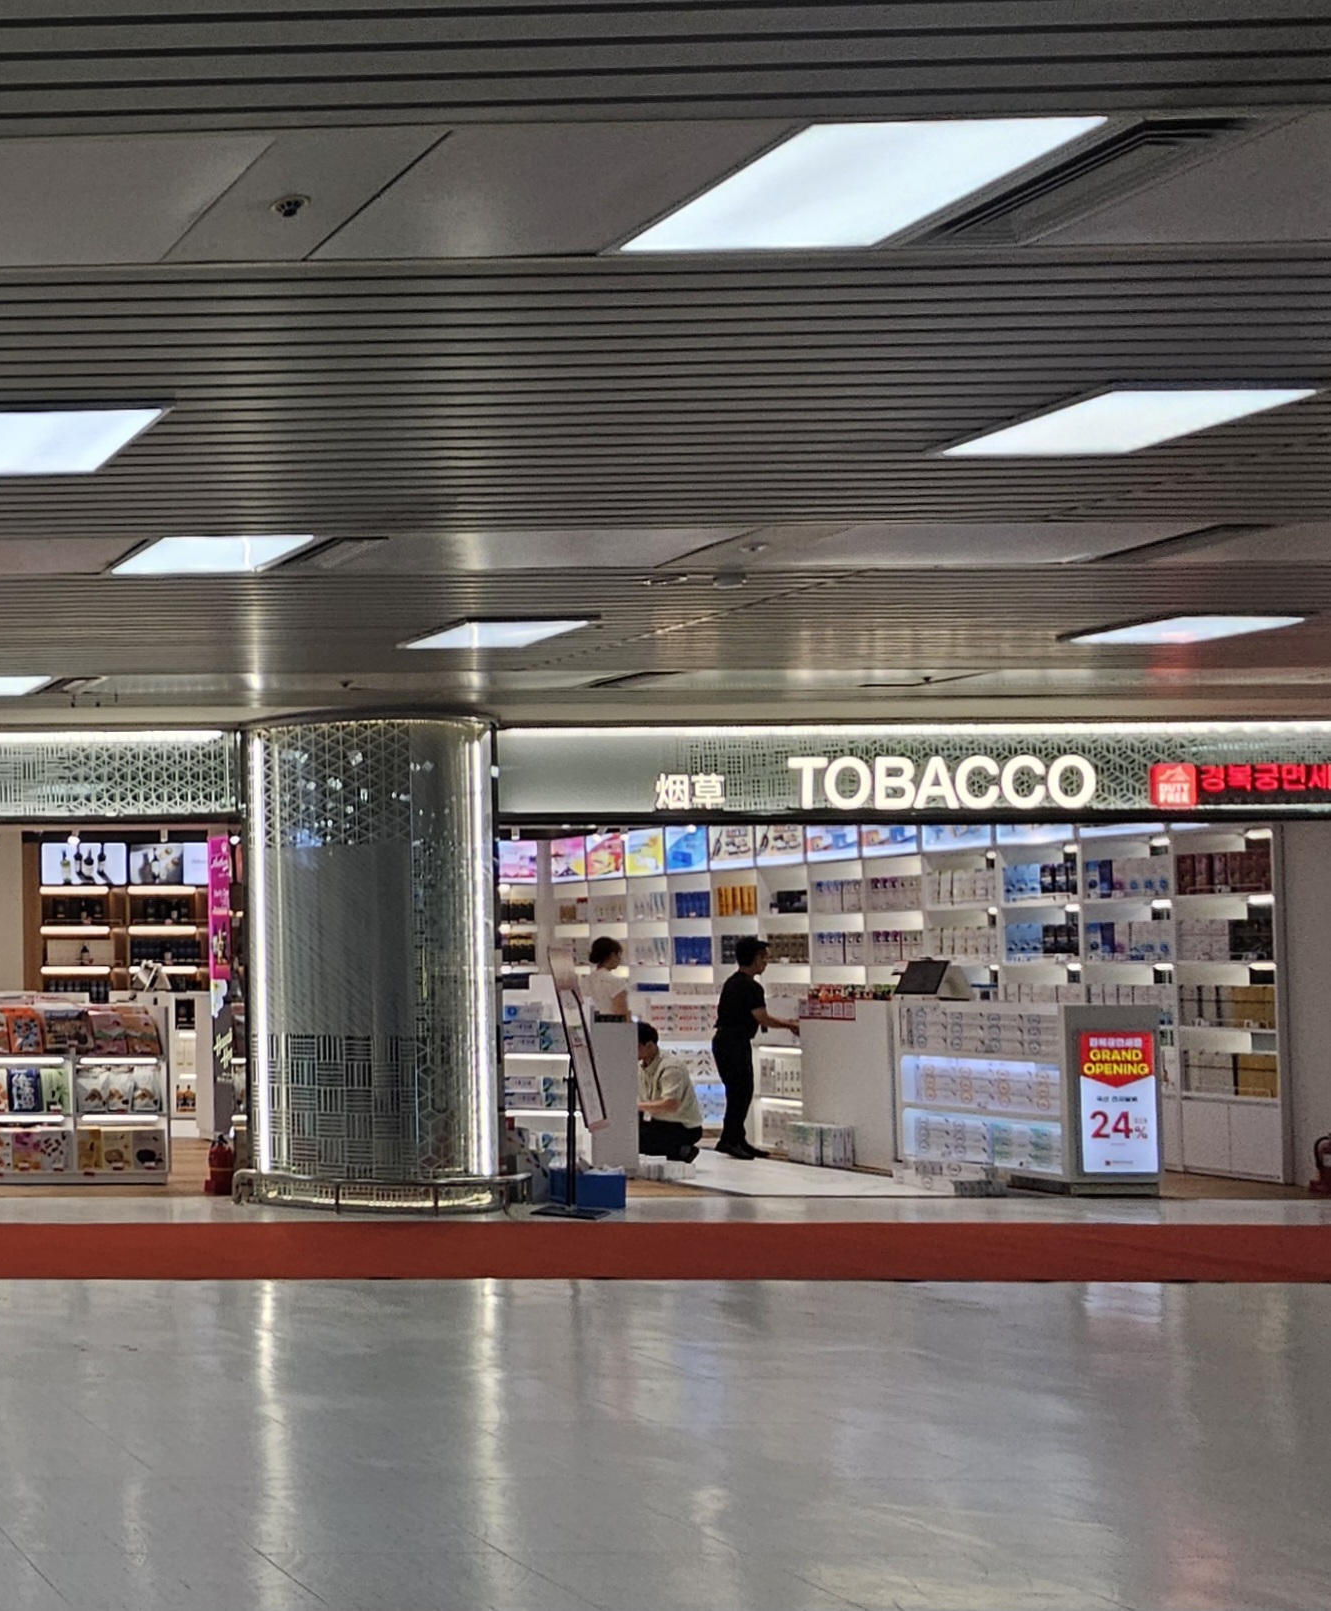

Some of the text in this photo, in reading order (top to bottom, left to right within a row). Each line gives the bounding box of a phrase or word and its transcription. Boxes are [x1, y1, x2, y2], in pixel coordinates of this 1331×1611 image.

[655, 772, 726, 810] 烟草
[788, 755, 1096, 811] TOBACCO
[1089, 1049, 1143, 1062] GRAND
[1083, 1062, 1150, 1076] OPENING
